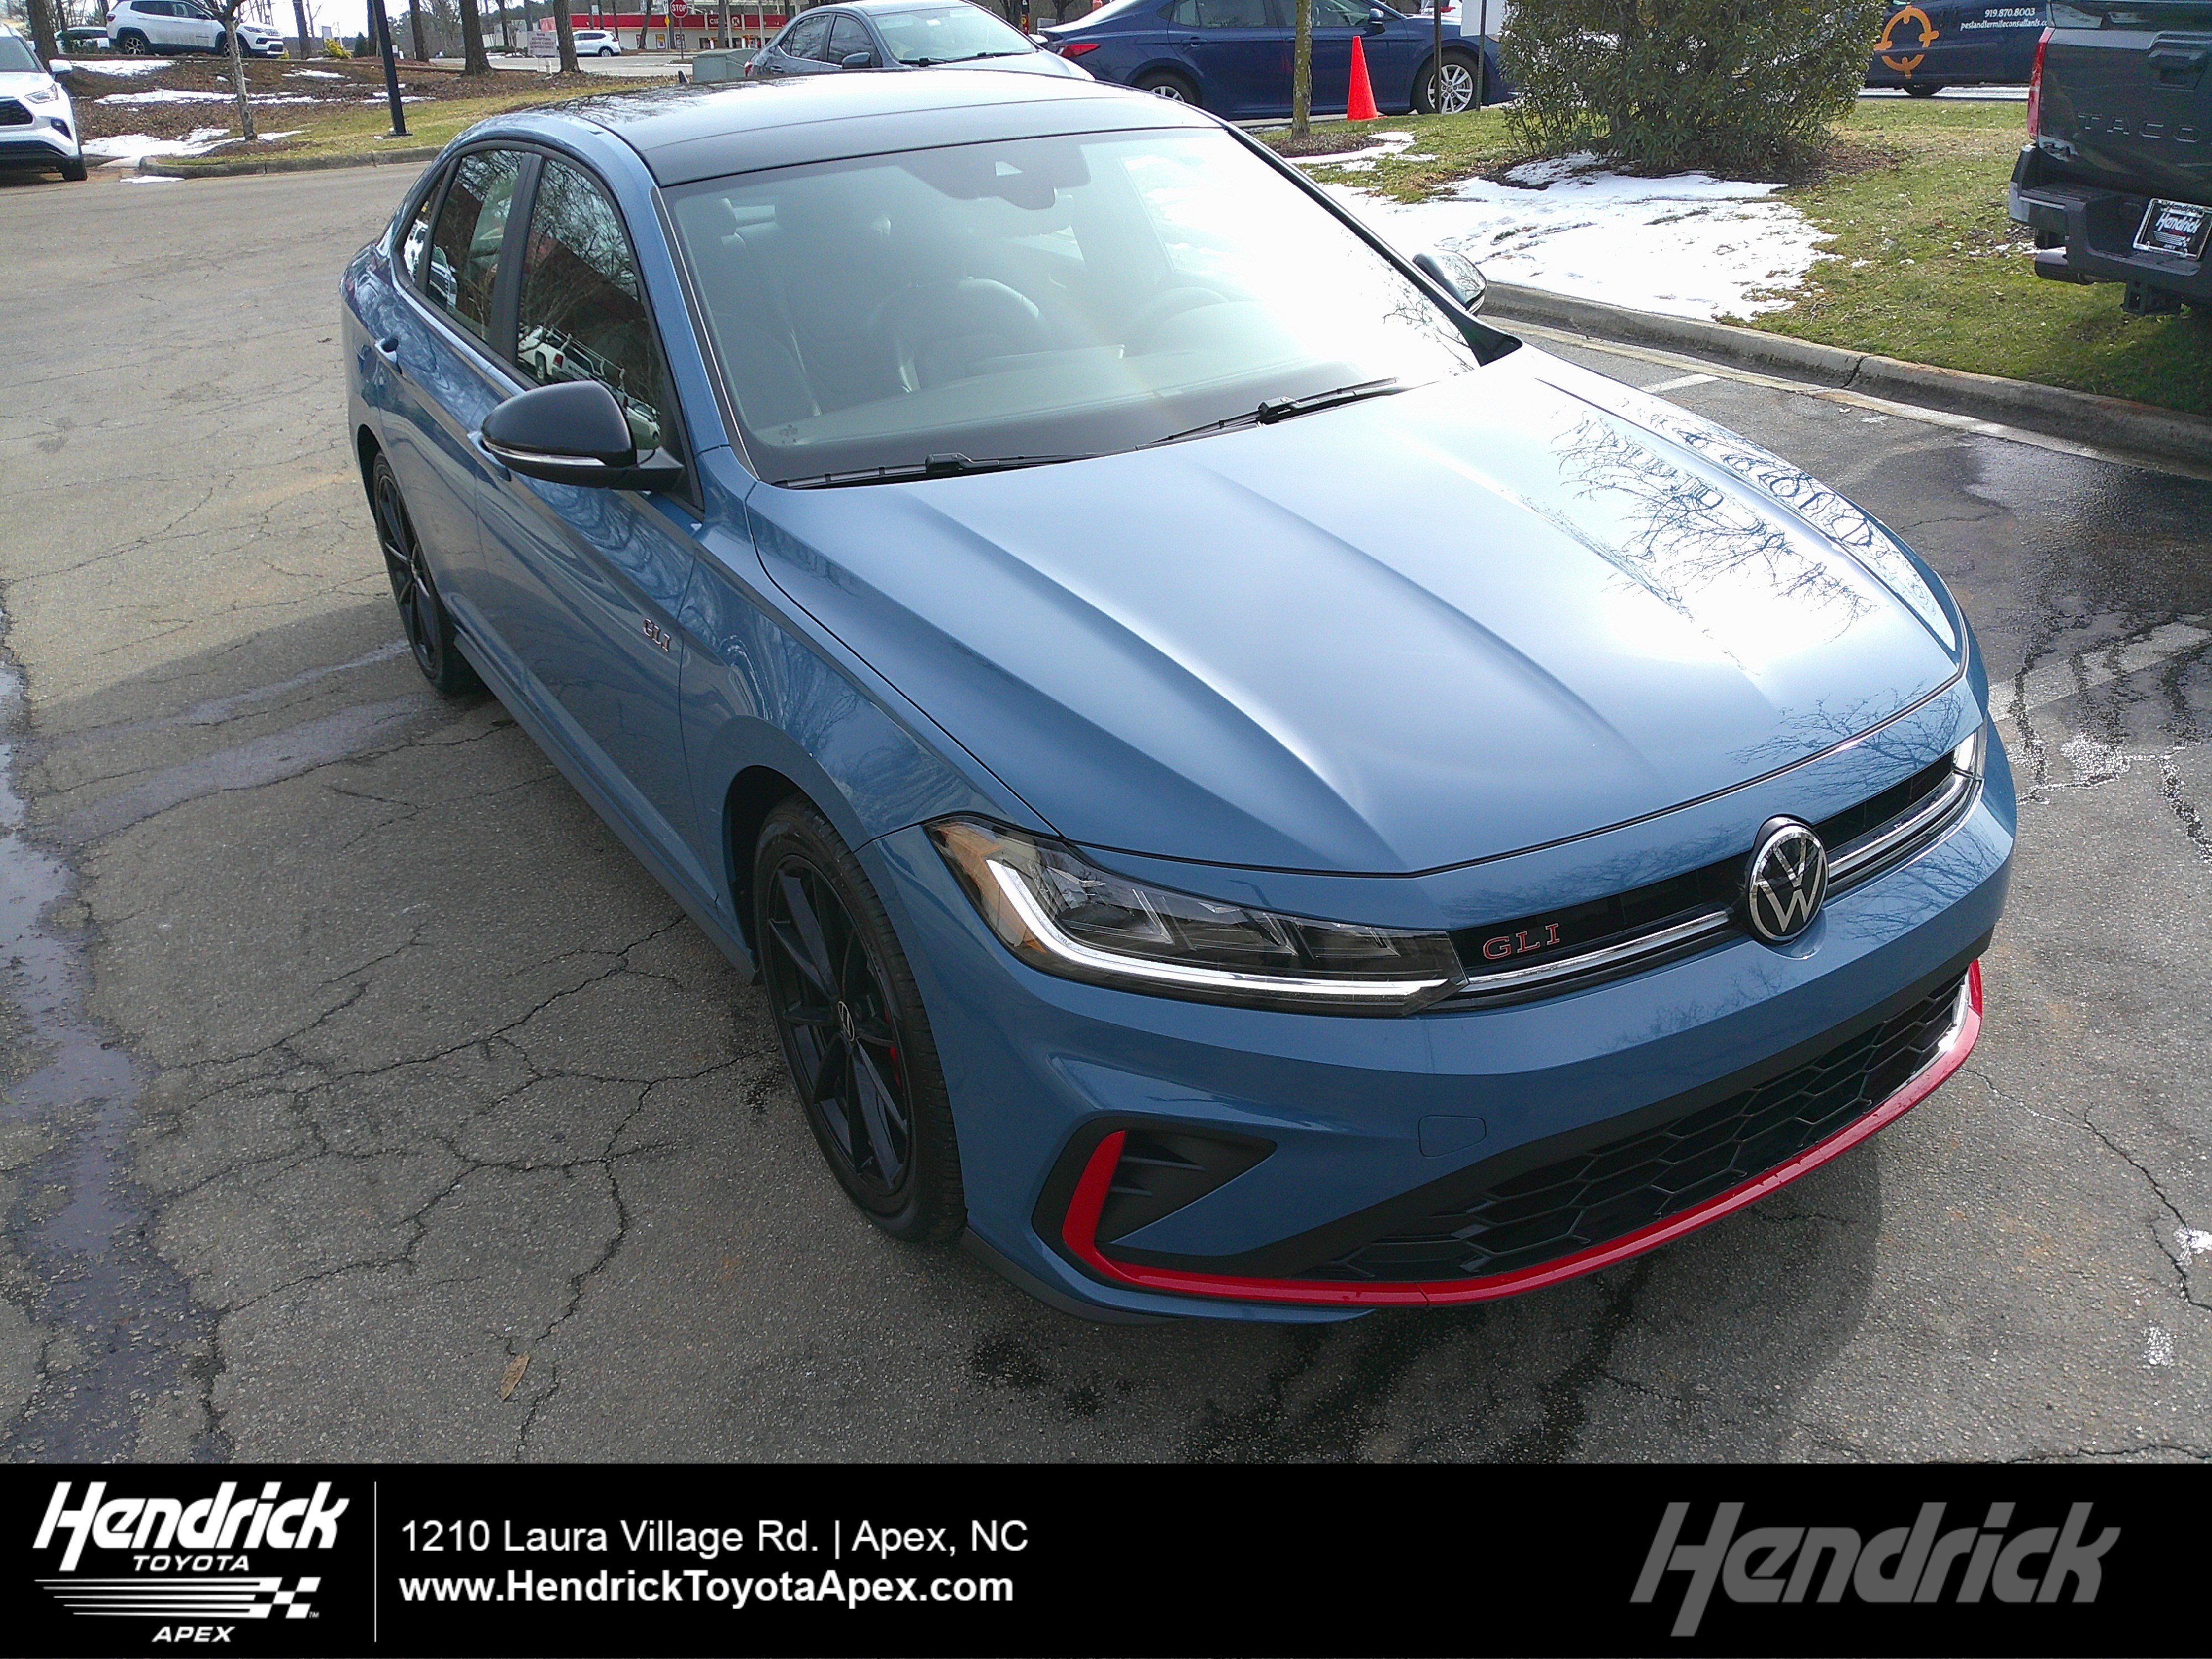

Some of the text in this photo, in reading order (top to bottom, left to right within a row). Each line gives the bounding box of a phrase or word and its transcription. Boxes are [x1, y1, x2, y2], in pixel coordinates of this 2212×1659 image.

[1985, 8, 2036, 18] 919.870.8003
[2078, 112, 2203, 143] TACO
[2154, 211, 2202, 234] Hendrick
[642, 618, 671, 652] GLI
[1482, 923, 1561, 960] GLI
